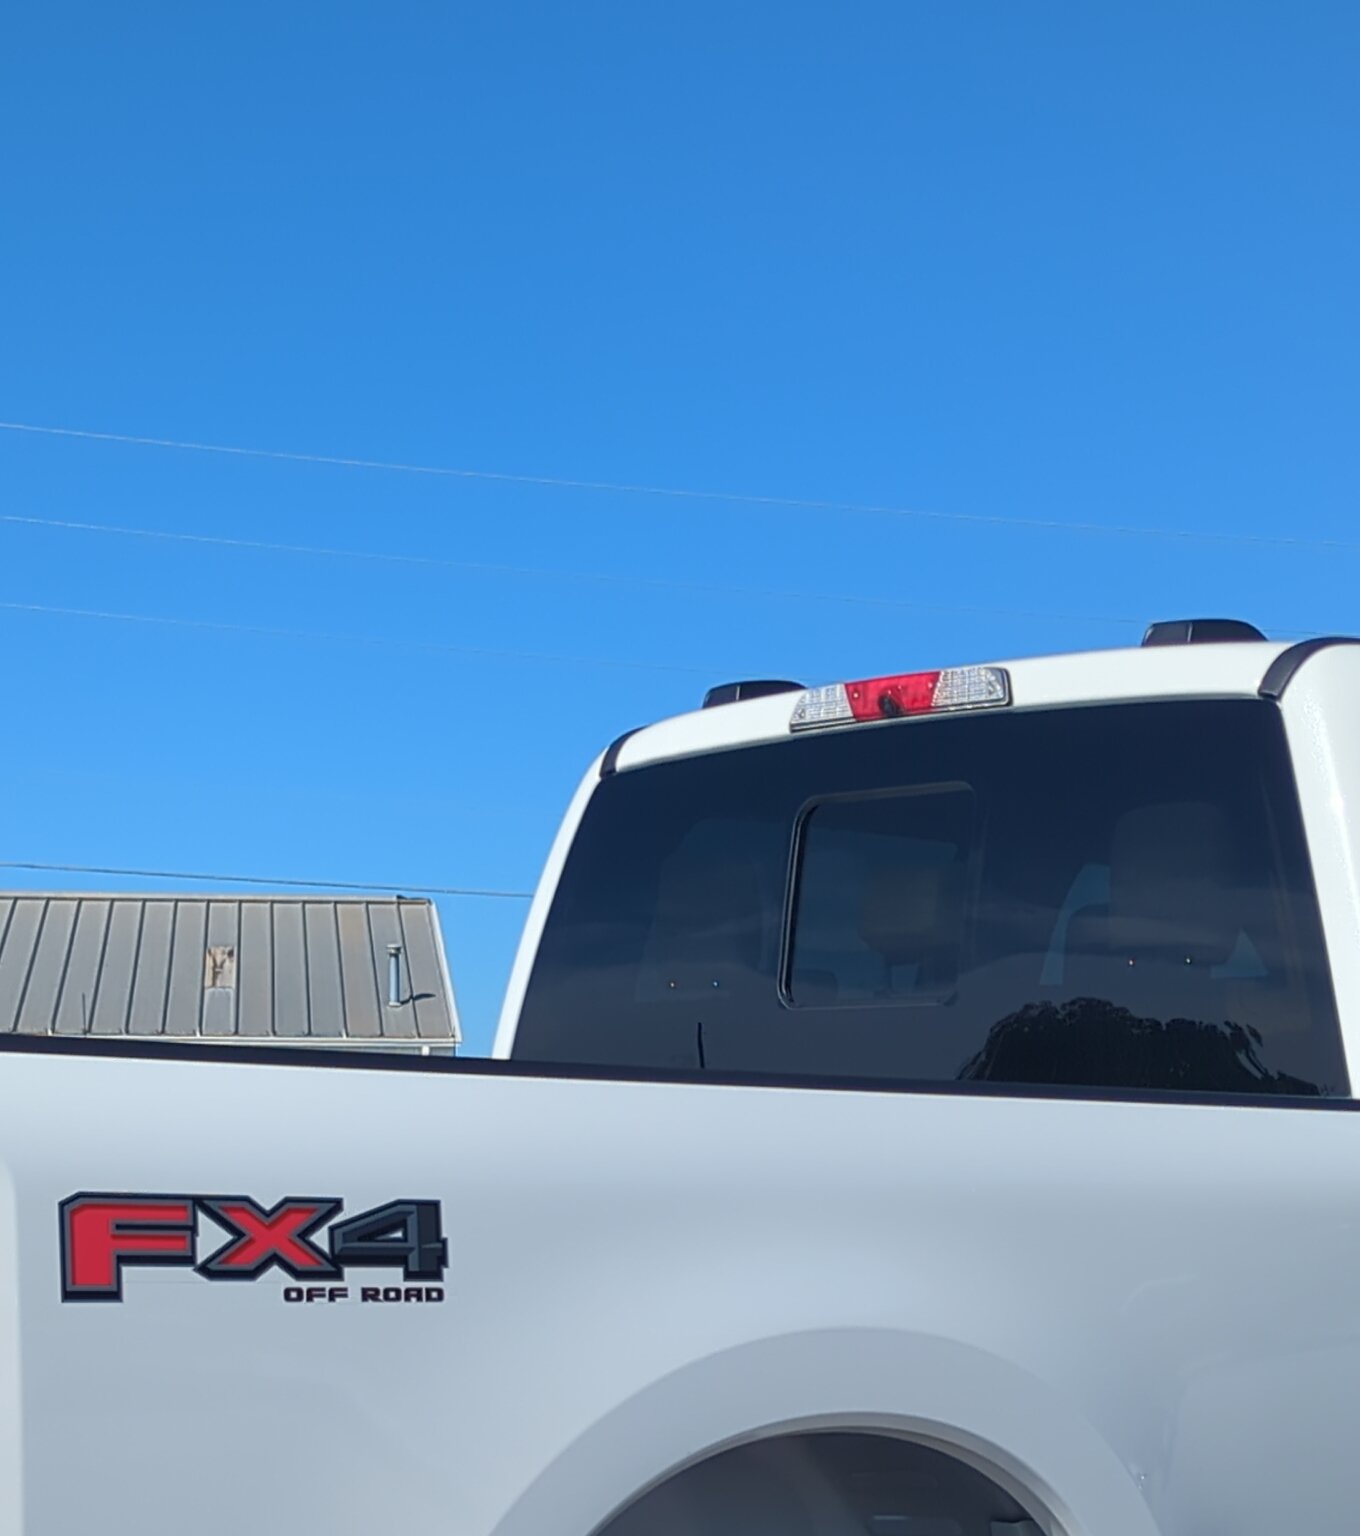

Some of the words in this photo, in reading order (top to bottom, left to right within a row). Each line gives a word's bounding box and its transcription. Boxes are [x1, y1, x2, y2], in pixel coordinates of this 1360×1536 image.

[58, 1191, 448, 1302] FX4
[283, 1286, 349, 1303] OFF
[360, 1286, 446, 1303] ROAD
